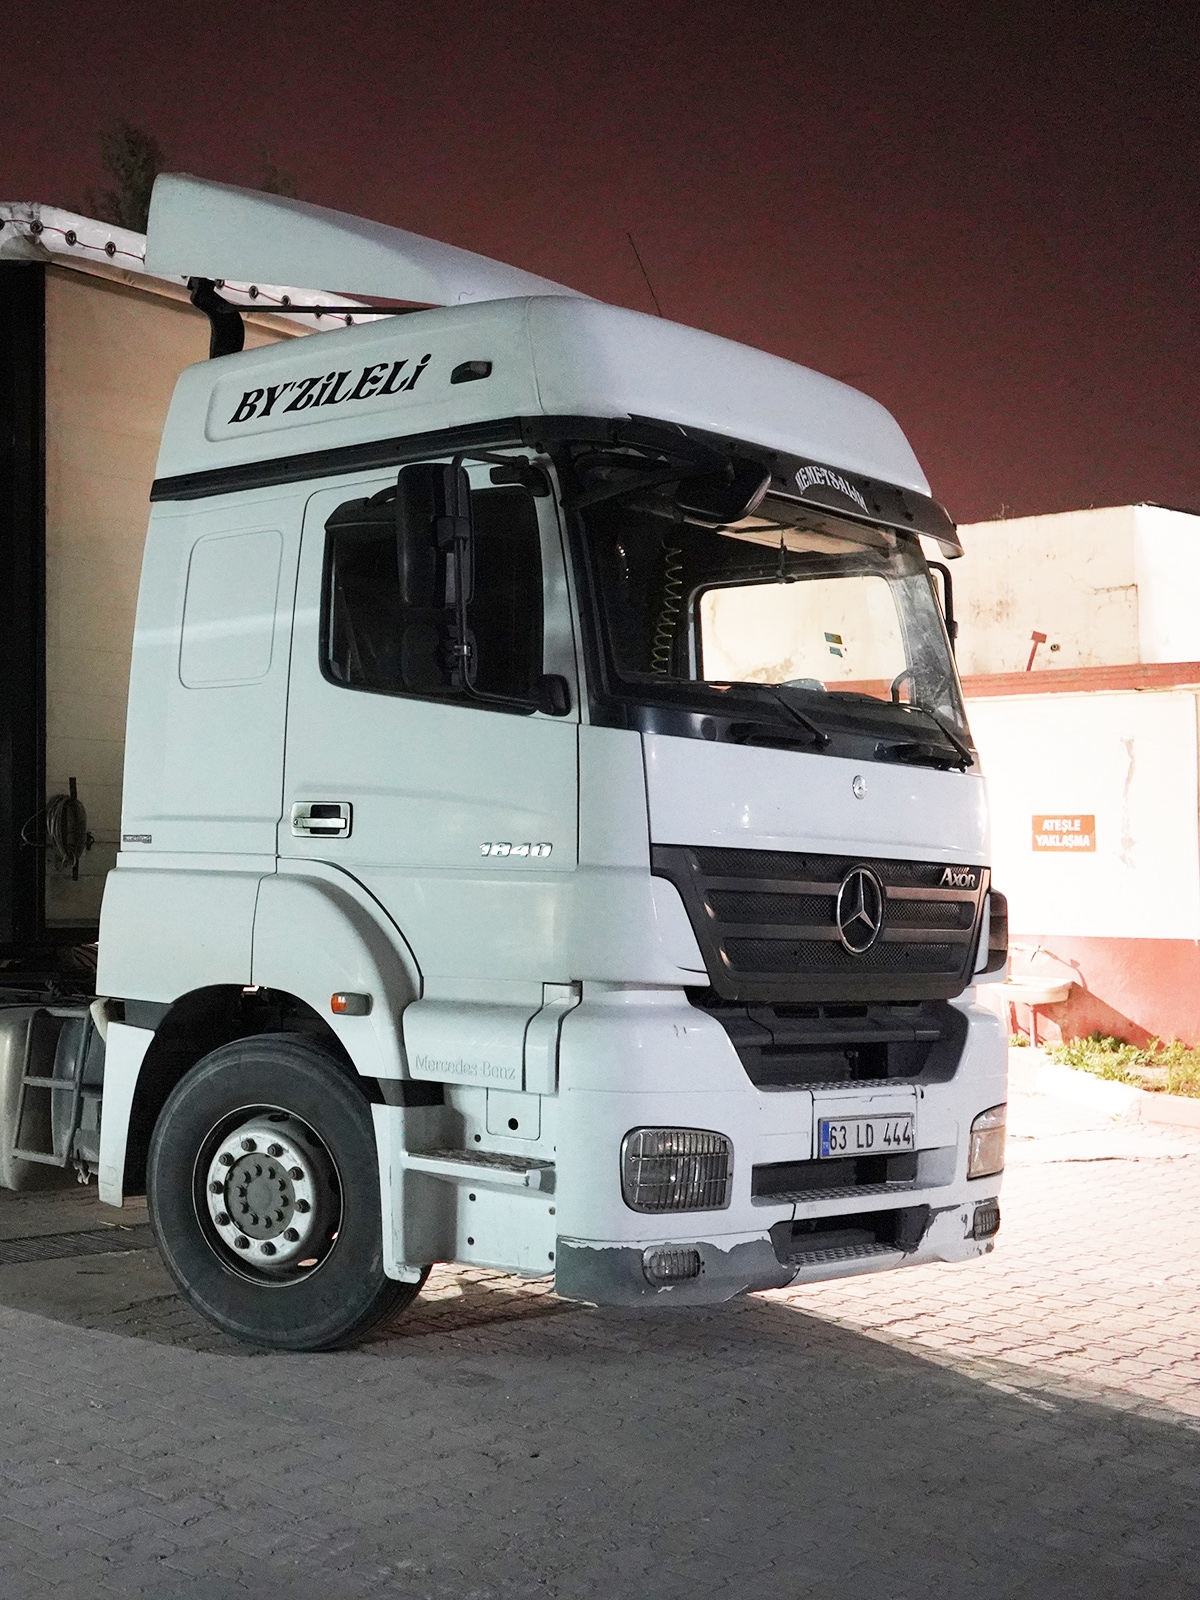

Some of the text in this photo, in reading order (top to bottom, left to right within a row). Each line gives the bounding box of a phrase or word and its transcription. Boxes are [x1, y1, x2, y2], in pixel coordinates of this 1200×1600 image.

[1042, 819, 1081, 833] ATEŞLE
[1035, 834, 1091, 848] YAKLAŞMA
[479, 842, 553, 858] 1840
[415, 1054, 516, 1080] Mercedes-Benz
[830, 1126, 847, 1150] 63
[856, 1123, 874, 1148] LD
[883, 1122, 911, 1146] 444
